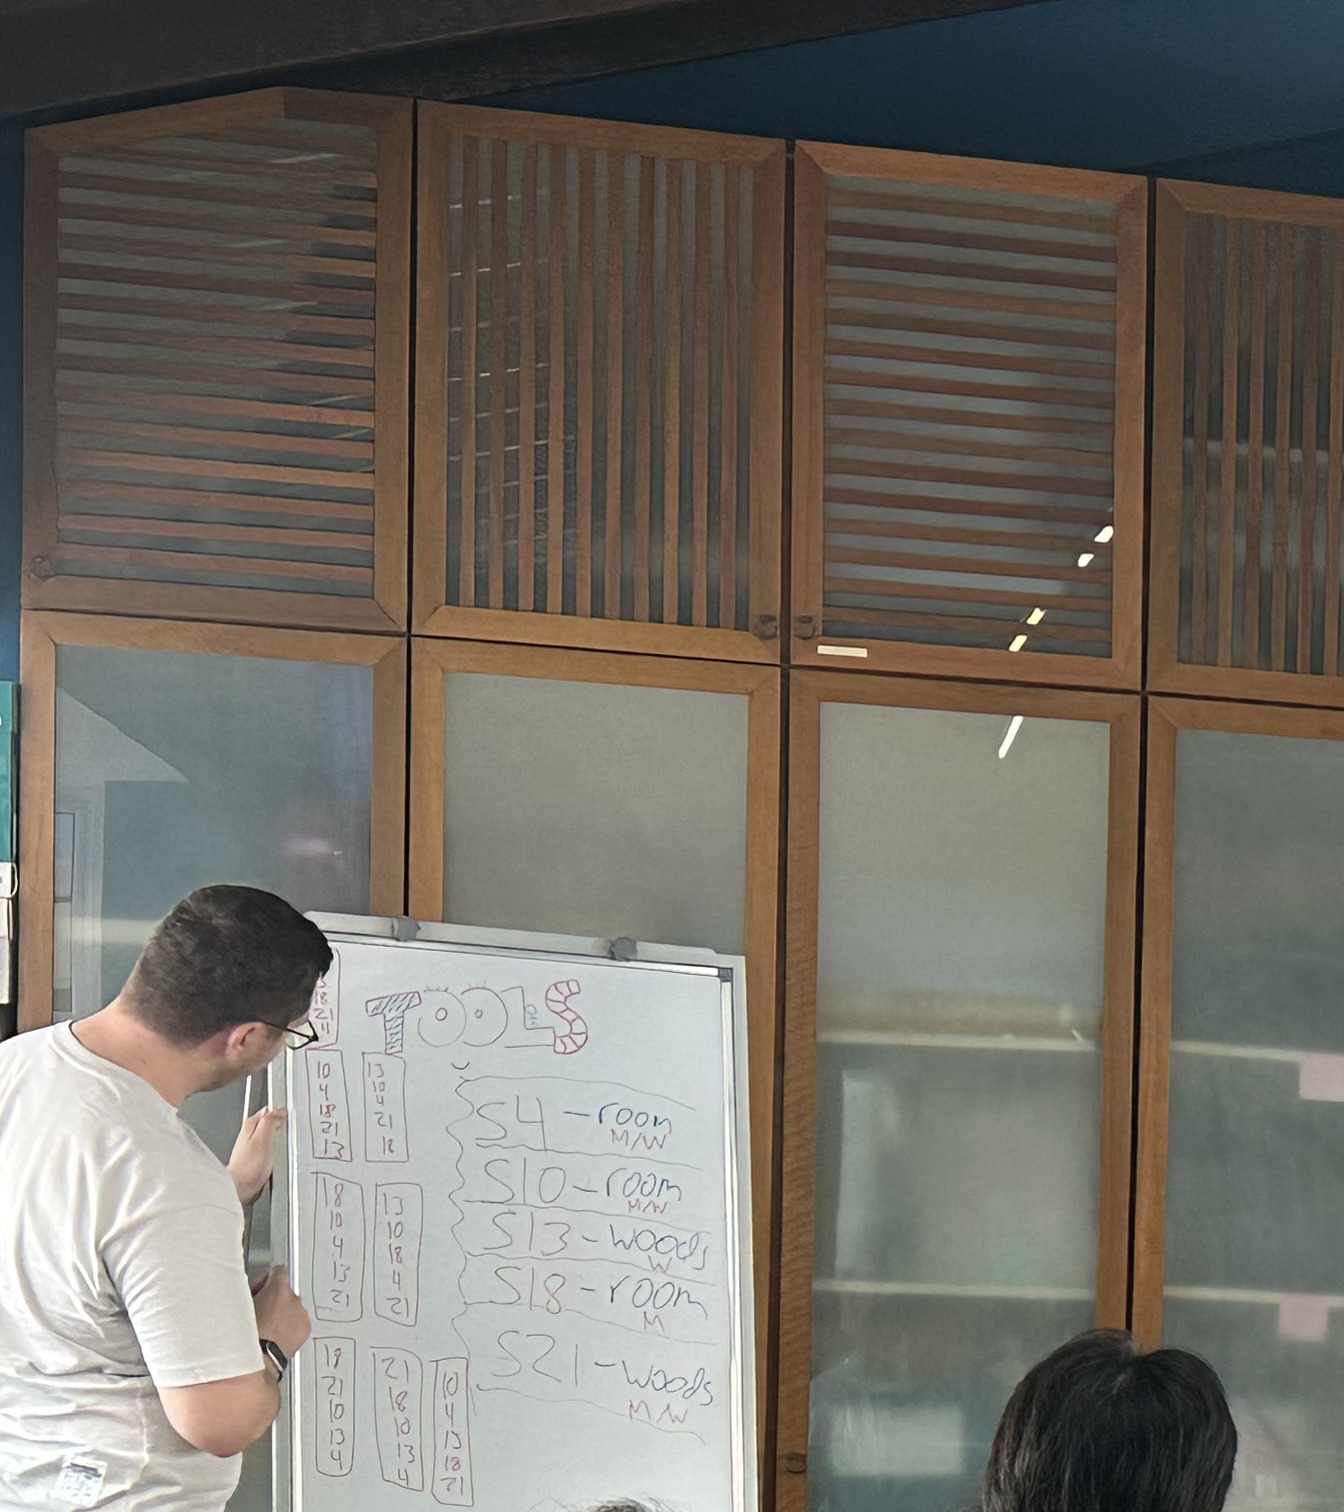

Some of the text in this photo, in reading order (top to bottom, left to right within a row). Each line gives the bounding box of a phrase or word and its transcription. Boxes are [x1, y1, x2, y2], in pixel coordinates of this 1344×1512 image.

[365, 979, 589, 1055] TOOLS
[317, 1061, 331, 1080] 10
[367, 1061, 385, 1079] 13
[322, 1177, 344, 1208] 18
[382, 1192, 404, 1216] 13
[330, 1209, 343, 1231] 10
[387, 1220, 404, 1240] 10
[329, 1399, 345, 1423] 10
[329, 1428, 346, 1446] 13
[394, 1416, 411, 1438] 10
